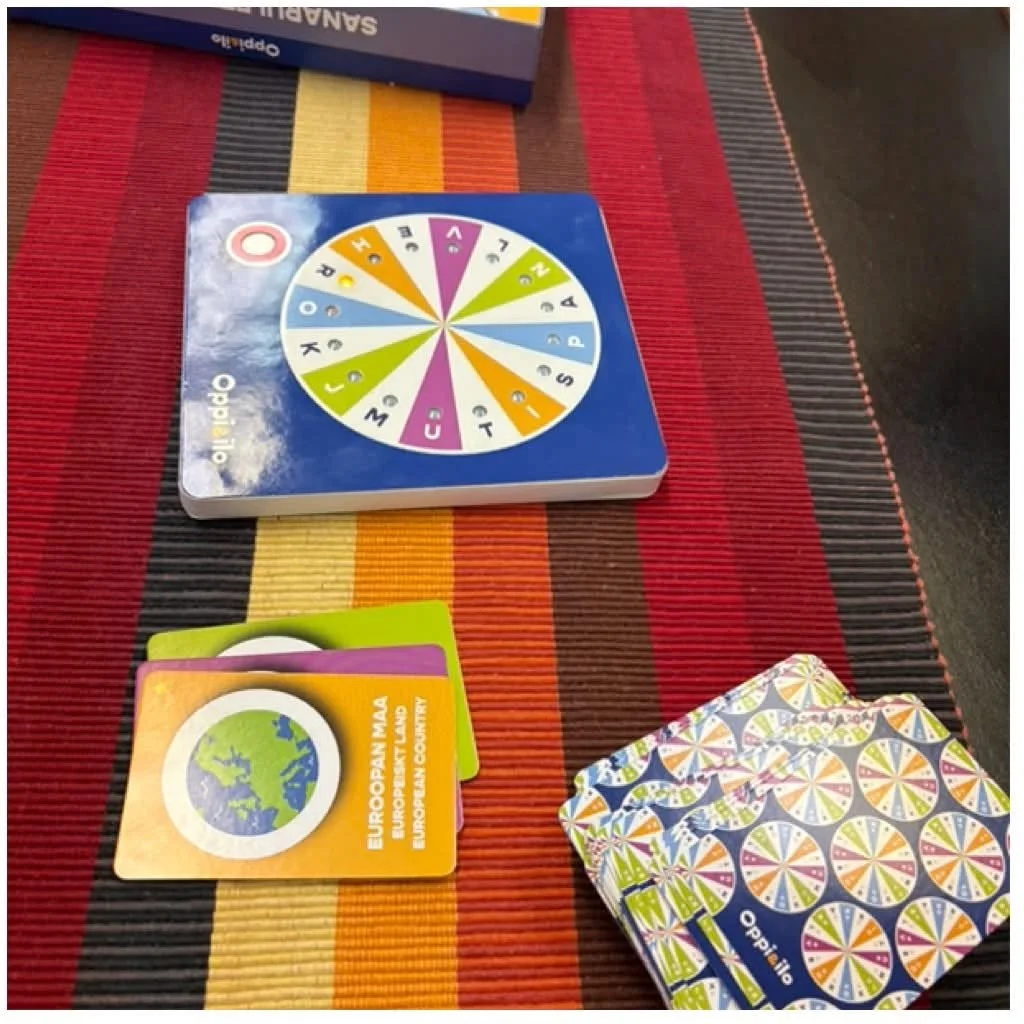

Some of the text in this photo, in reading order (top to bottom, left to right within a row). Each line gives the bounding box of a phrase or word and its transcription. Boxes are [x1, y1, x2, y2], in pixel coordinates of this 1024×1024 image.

[398, 225, 413, 238] E
[446, 225, 462, 240] V
[351, 237, 372, 253] H
[498, 238, 509, 252] L
[316, 263, 336, 279] R
[529, 261, 551, 278] N
[298, 300, 317, 316] O
[560, 295, 578, 308] A
[300, 341, 321, 356] K
[567, 335, 585, 348] P
[556, 372, 574, 387] S
[324, 383, 345, 394] J
[364, 407, 389, 427] M
[424, 424, 441, 440] U
[479, 422, 492, 438] T
[368, 696, 387, 850] EUROOPAN MAA
[392, 705, 407, 839] EUROPEISKT LAND
[413, 696, 427, 850] EUROPEAN COUNTRY
